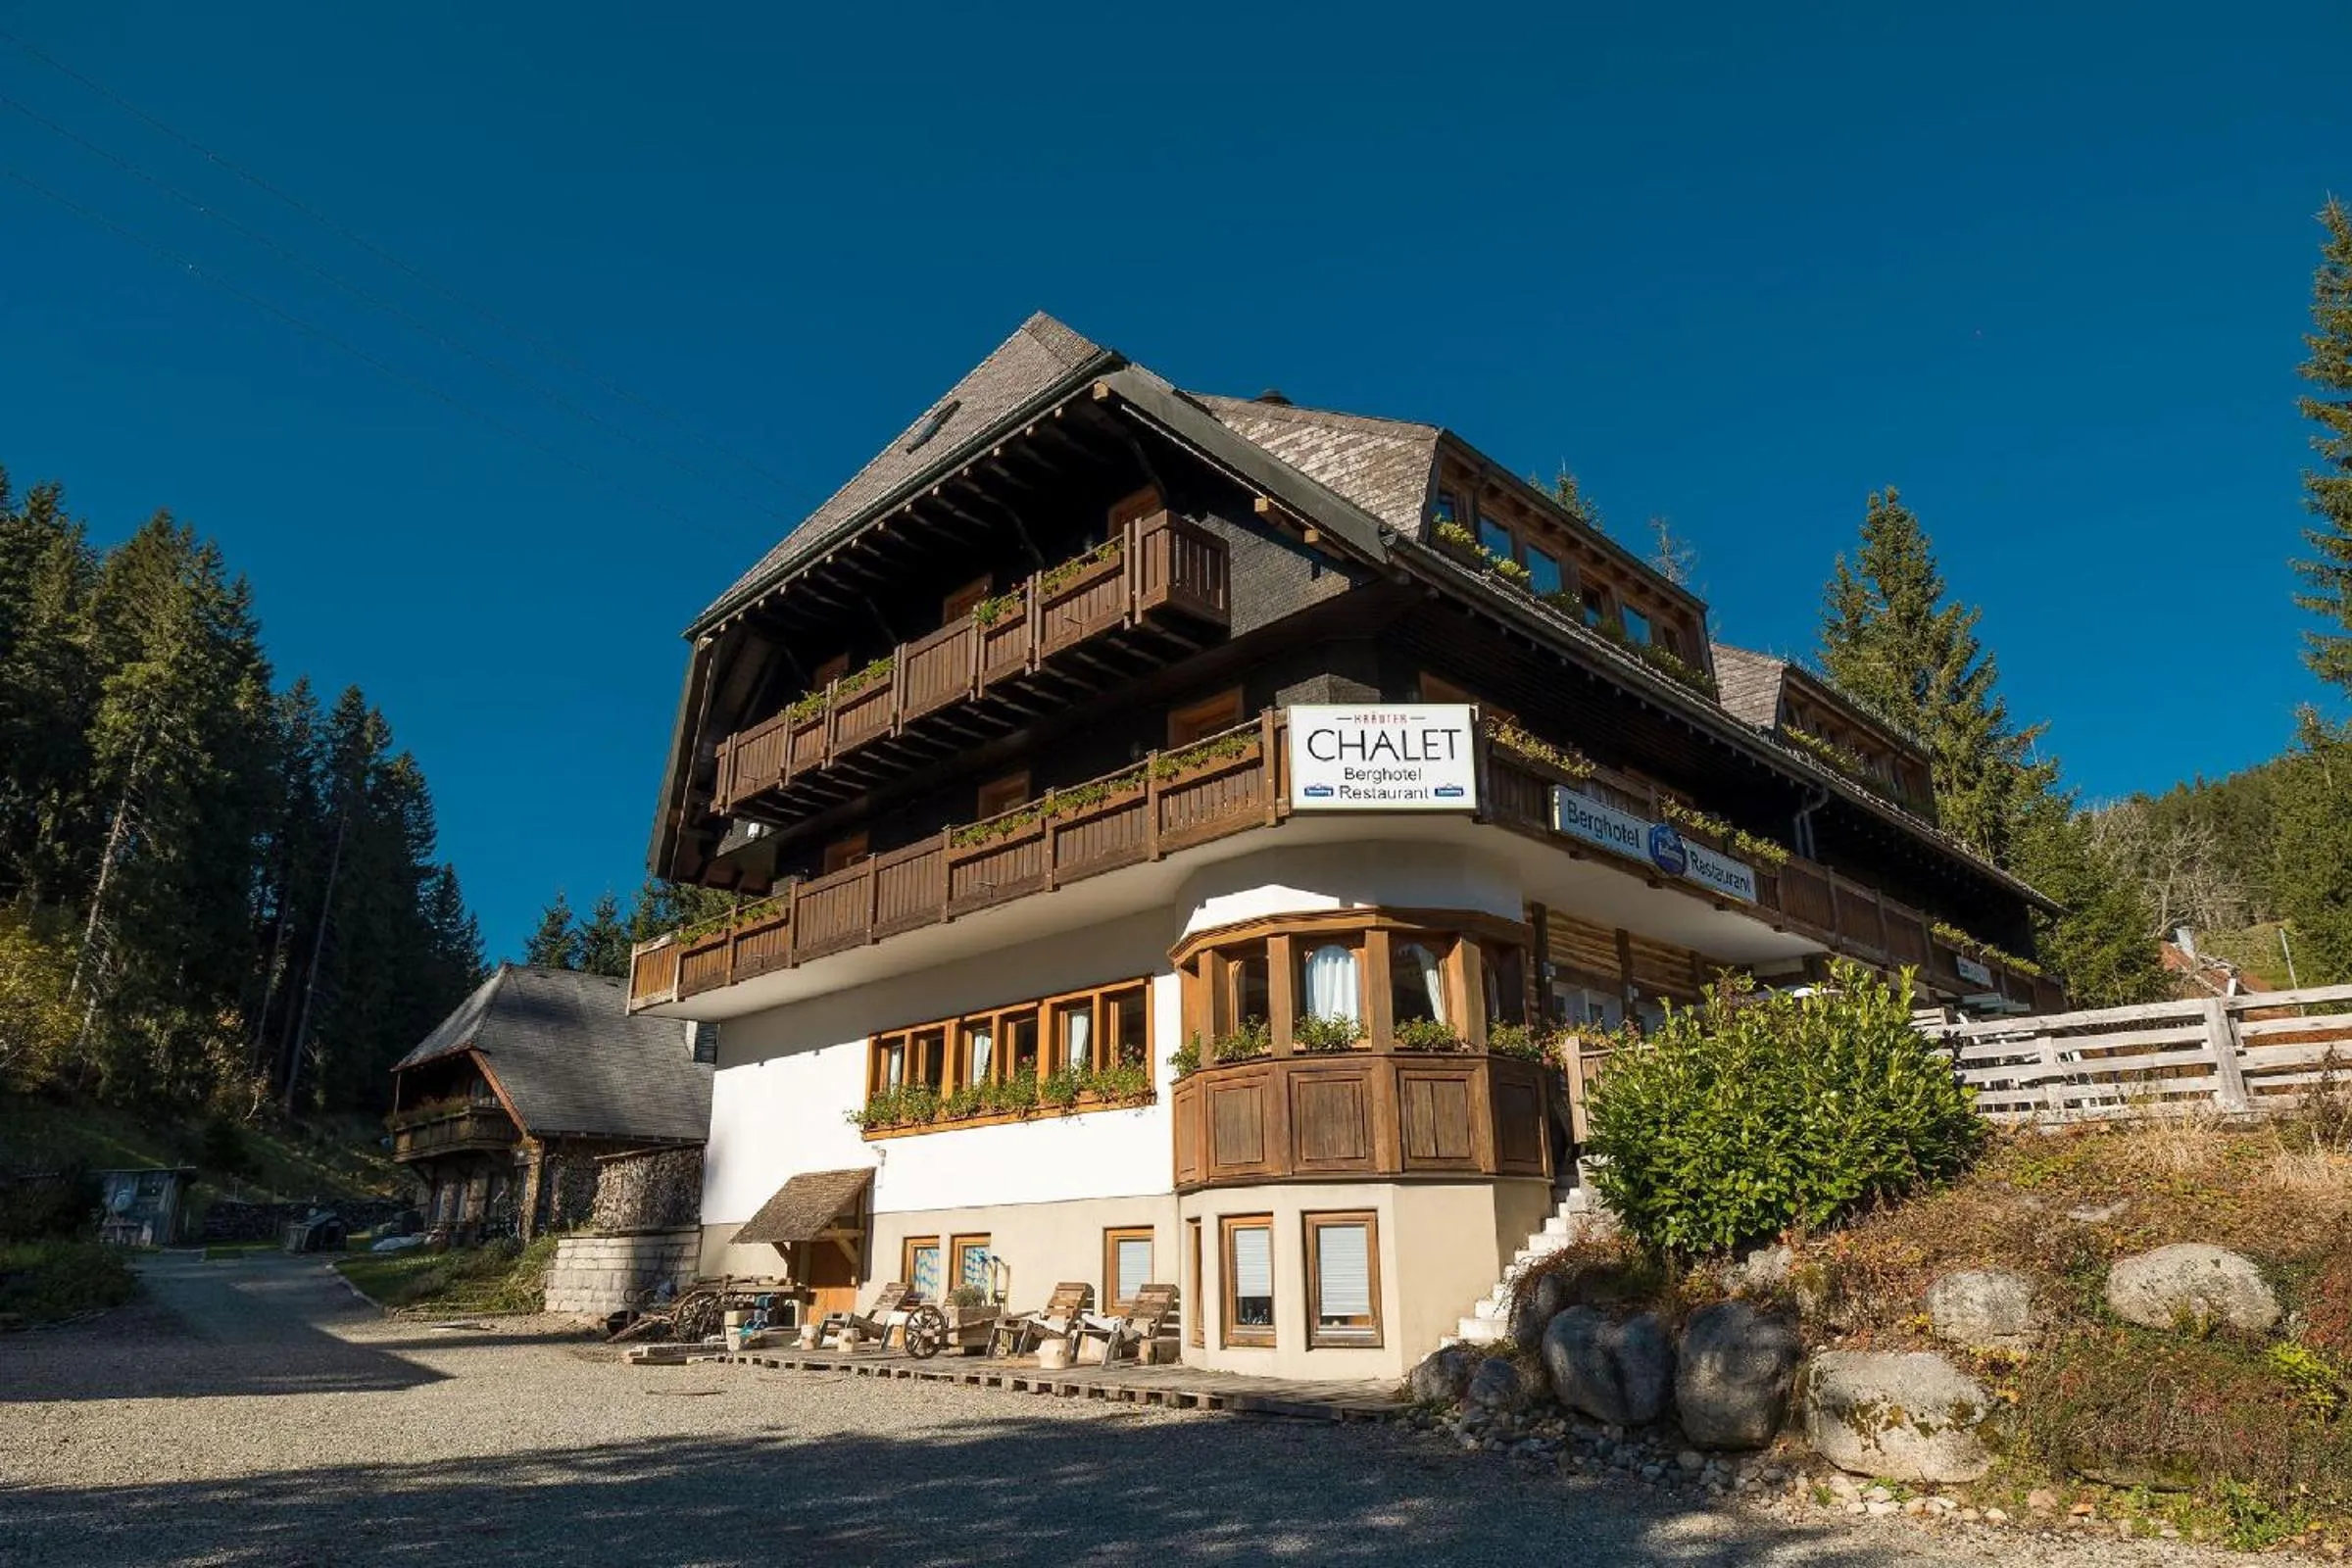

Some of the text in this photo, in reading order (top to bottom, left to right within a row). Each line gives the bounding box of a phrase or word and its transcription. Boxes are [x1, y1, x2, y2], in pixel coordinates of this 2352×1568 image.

[1307, 728, 1462, 761] CHALET
[1345, 767, 1422, 784] Berghotel
[1340, 785, 1429, 800] Restaurant
[1568, 799, 1641, 850] Berghotel
[1689, 850, 1751, 894] Restaurant
